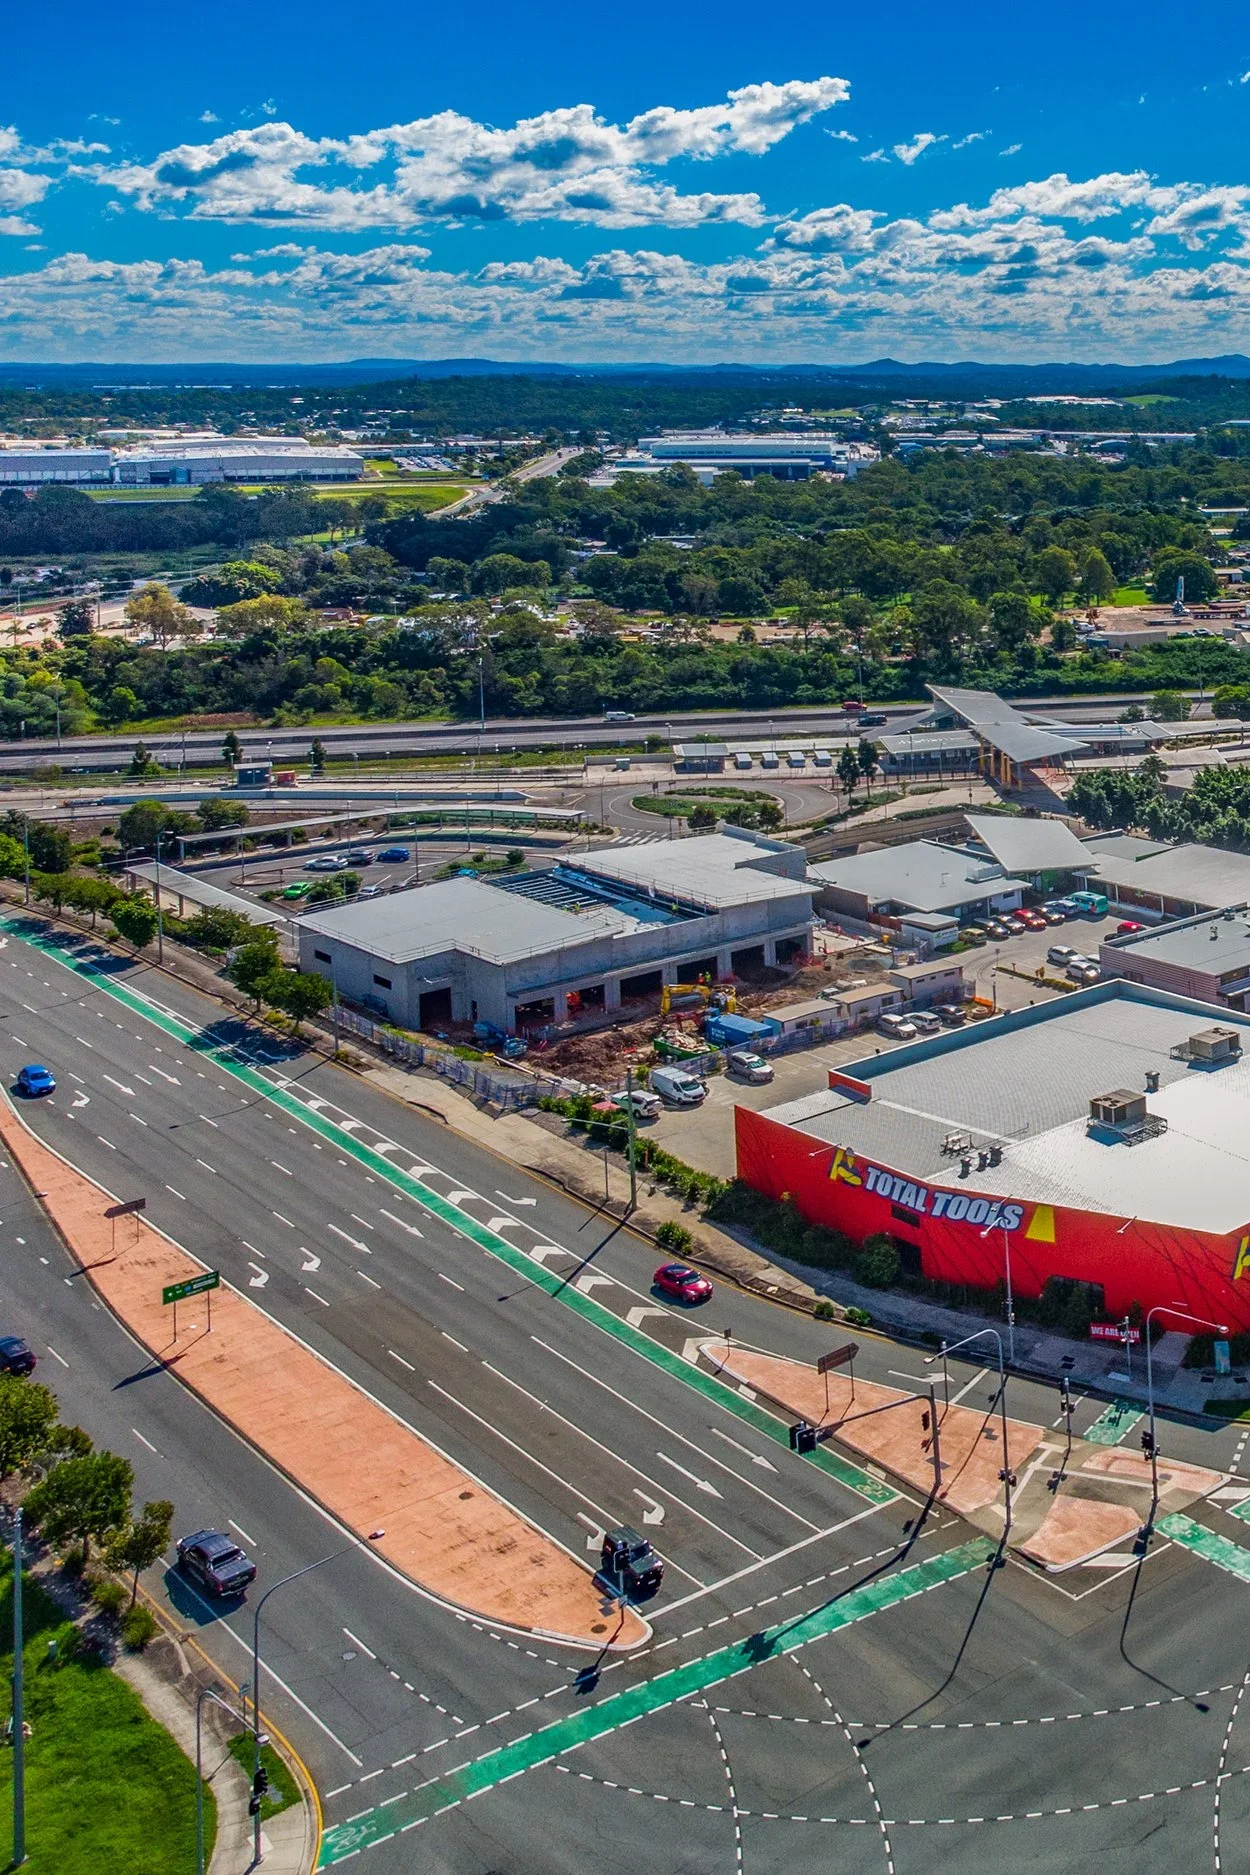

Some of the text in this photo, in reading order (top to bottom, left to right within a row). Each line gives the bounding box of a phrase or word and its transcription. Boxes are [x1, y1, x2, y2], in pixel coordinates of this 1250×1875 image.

[866, 1166, 1024, 1230] TOTAL TOOLS
[1091, 1326, 1104, 1335] WE
[1105, 1327, 1119, 1337] ARE
